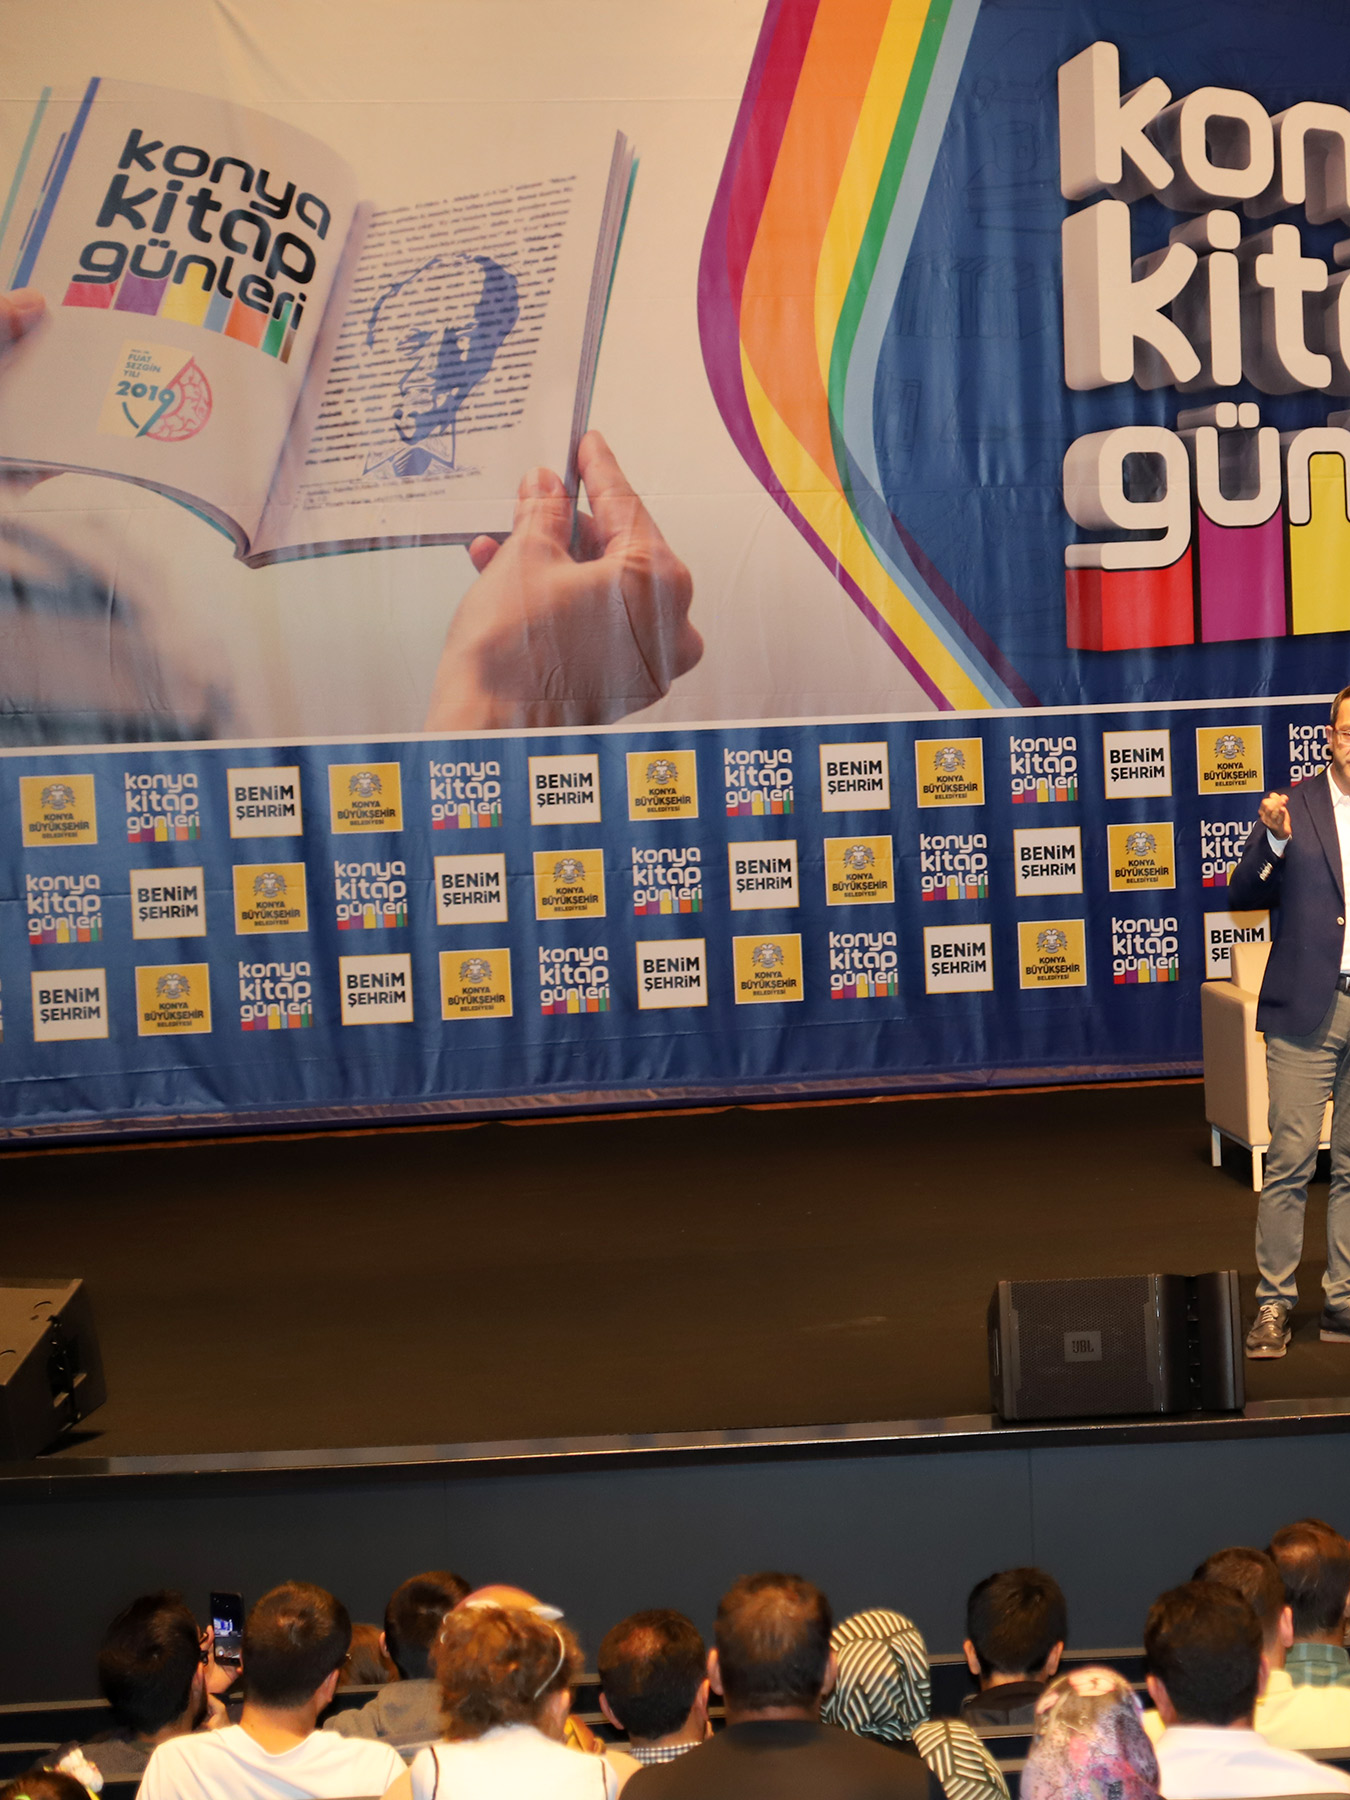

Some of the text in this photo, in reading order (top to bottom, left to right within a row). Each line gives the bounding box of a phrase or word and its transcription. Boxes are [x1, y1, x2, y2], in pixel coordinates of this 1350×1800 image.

[118, 128, 332, 241] konya
[95, 173, 317, 285] kitap
[71, 238, 308, 331] günleri
[1010, 736, 1076, 756] konya
[725, 748, 791, 768] konya
[1011, 753, 1077, 776] kitap
[1217, 762, 1243, 770] KONYA
[430, 760, 500, 781] konya
[725, 765, 792, 788] kitap
[124, 772, 198, 793] konya
[431, 778, 501, 802] kitap
[125, 790, 199, 814] kitap
[920, 833, 986, 853] konya
[632, 847, 700, 867] konya
[921, 850, 987, 873] kitap
[1128, 859, 1155, 867] KONYA
[335, 860, 405, 880] konya
[633, 864, 701, 887] kitap
[26, 874, 100, 894] konya
[336, 878, 406, 901] kitap
[27, 892, 100, 915] kitap
[1112, 917, 1177, 936] konya
[830, 931, 895, 951] konya
[1113, 934, 1178, 957] kitap
[540, 945, 608, 965] konya
[830, 948, 896, 971] kitap
[239, 961, 310, 981] konya
[540, 963, 608, 986] kitap
[240, 978, 311, 1002] kitap
[1072, 1339, 1095, 1354] JBL
